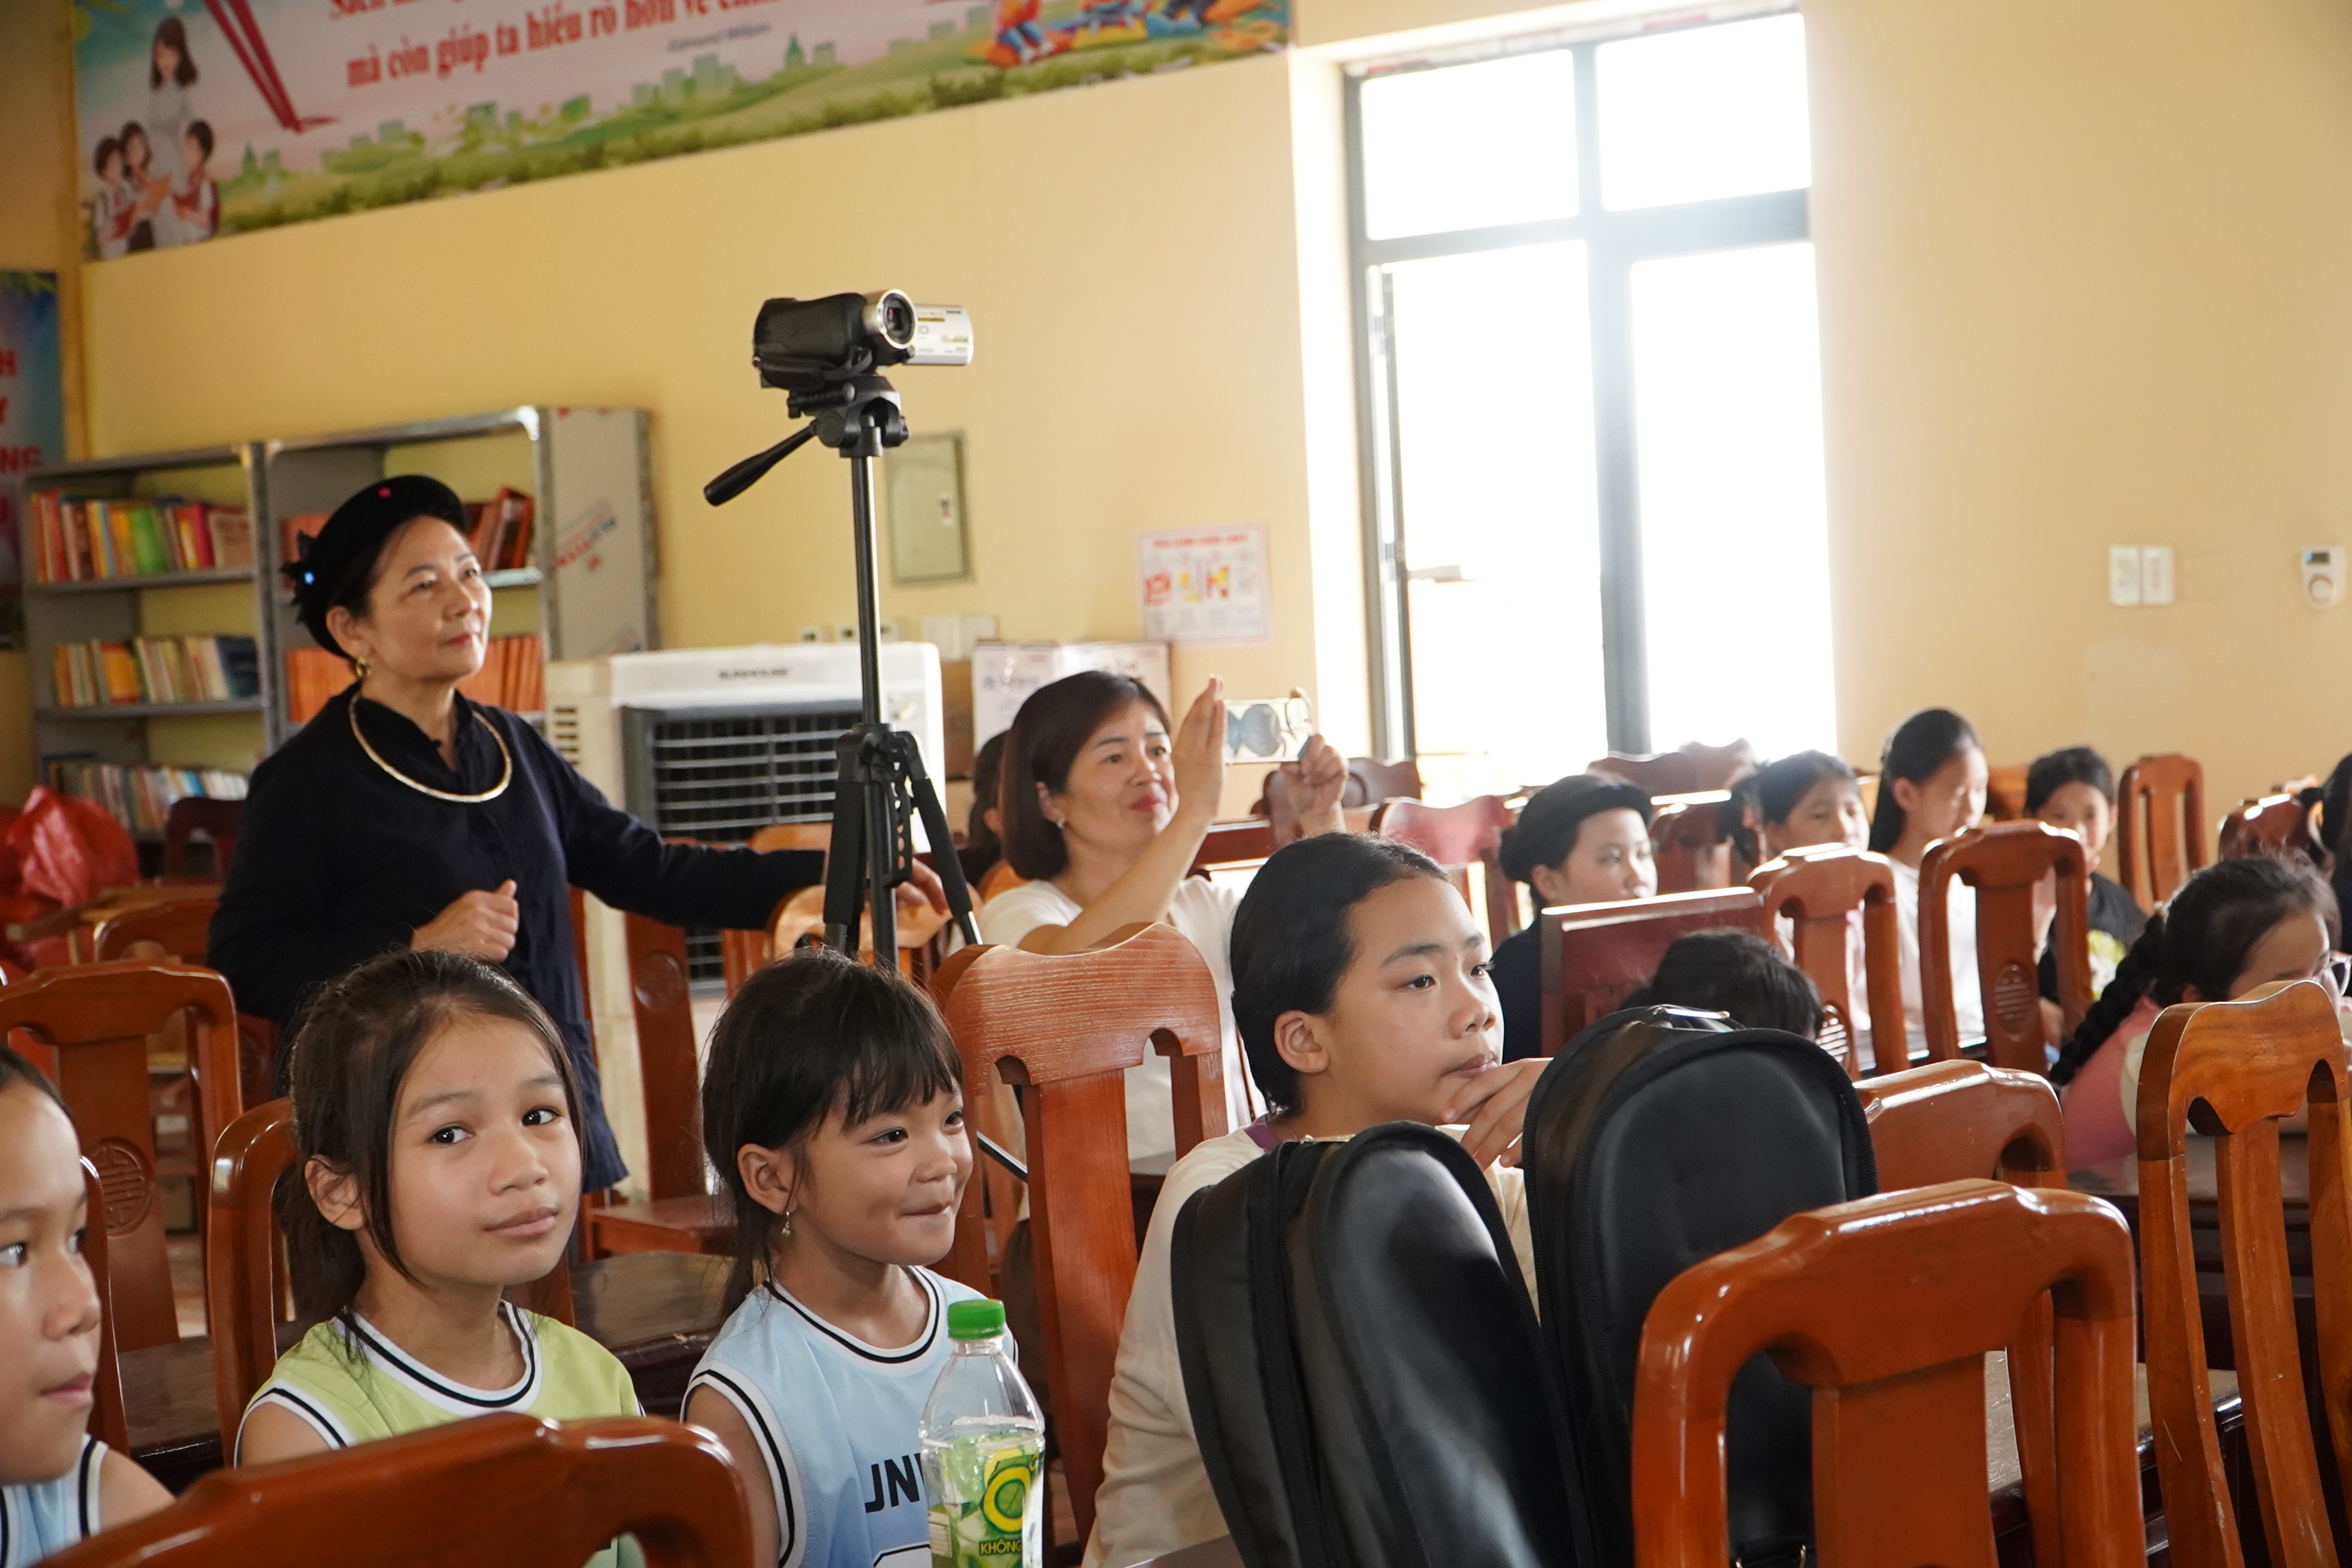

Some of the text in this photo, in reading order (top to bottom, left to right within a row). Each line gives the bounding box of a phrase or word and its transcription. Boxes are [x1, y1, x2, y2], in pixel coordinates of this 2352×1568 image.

[495, 22, 520, 56] ta
[865, 1453, 924, 1514] JN
[981, 1538, 1023, 1554] KHÔNG
